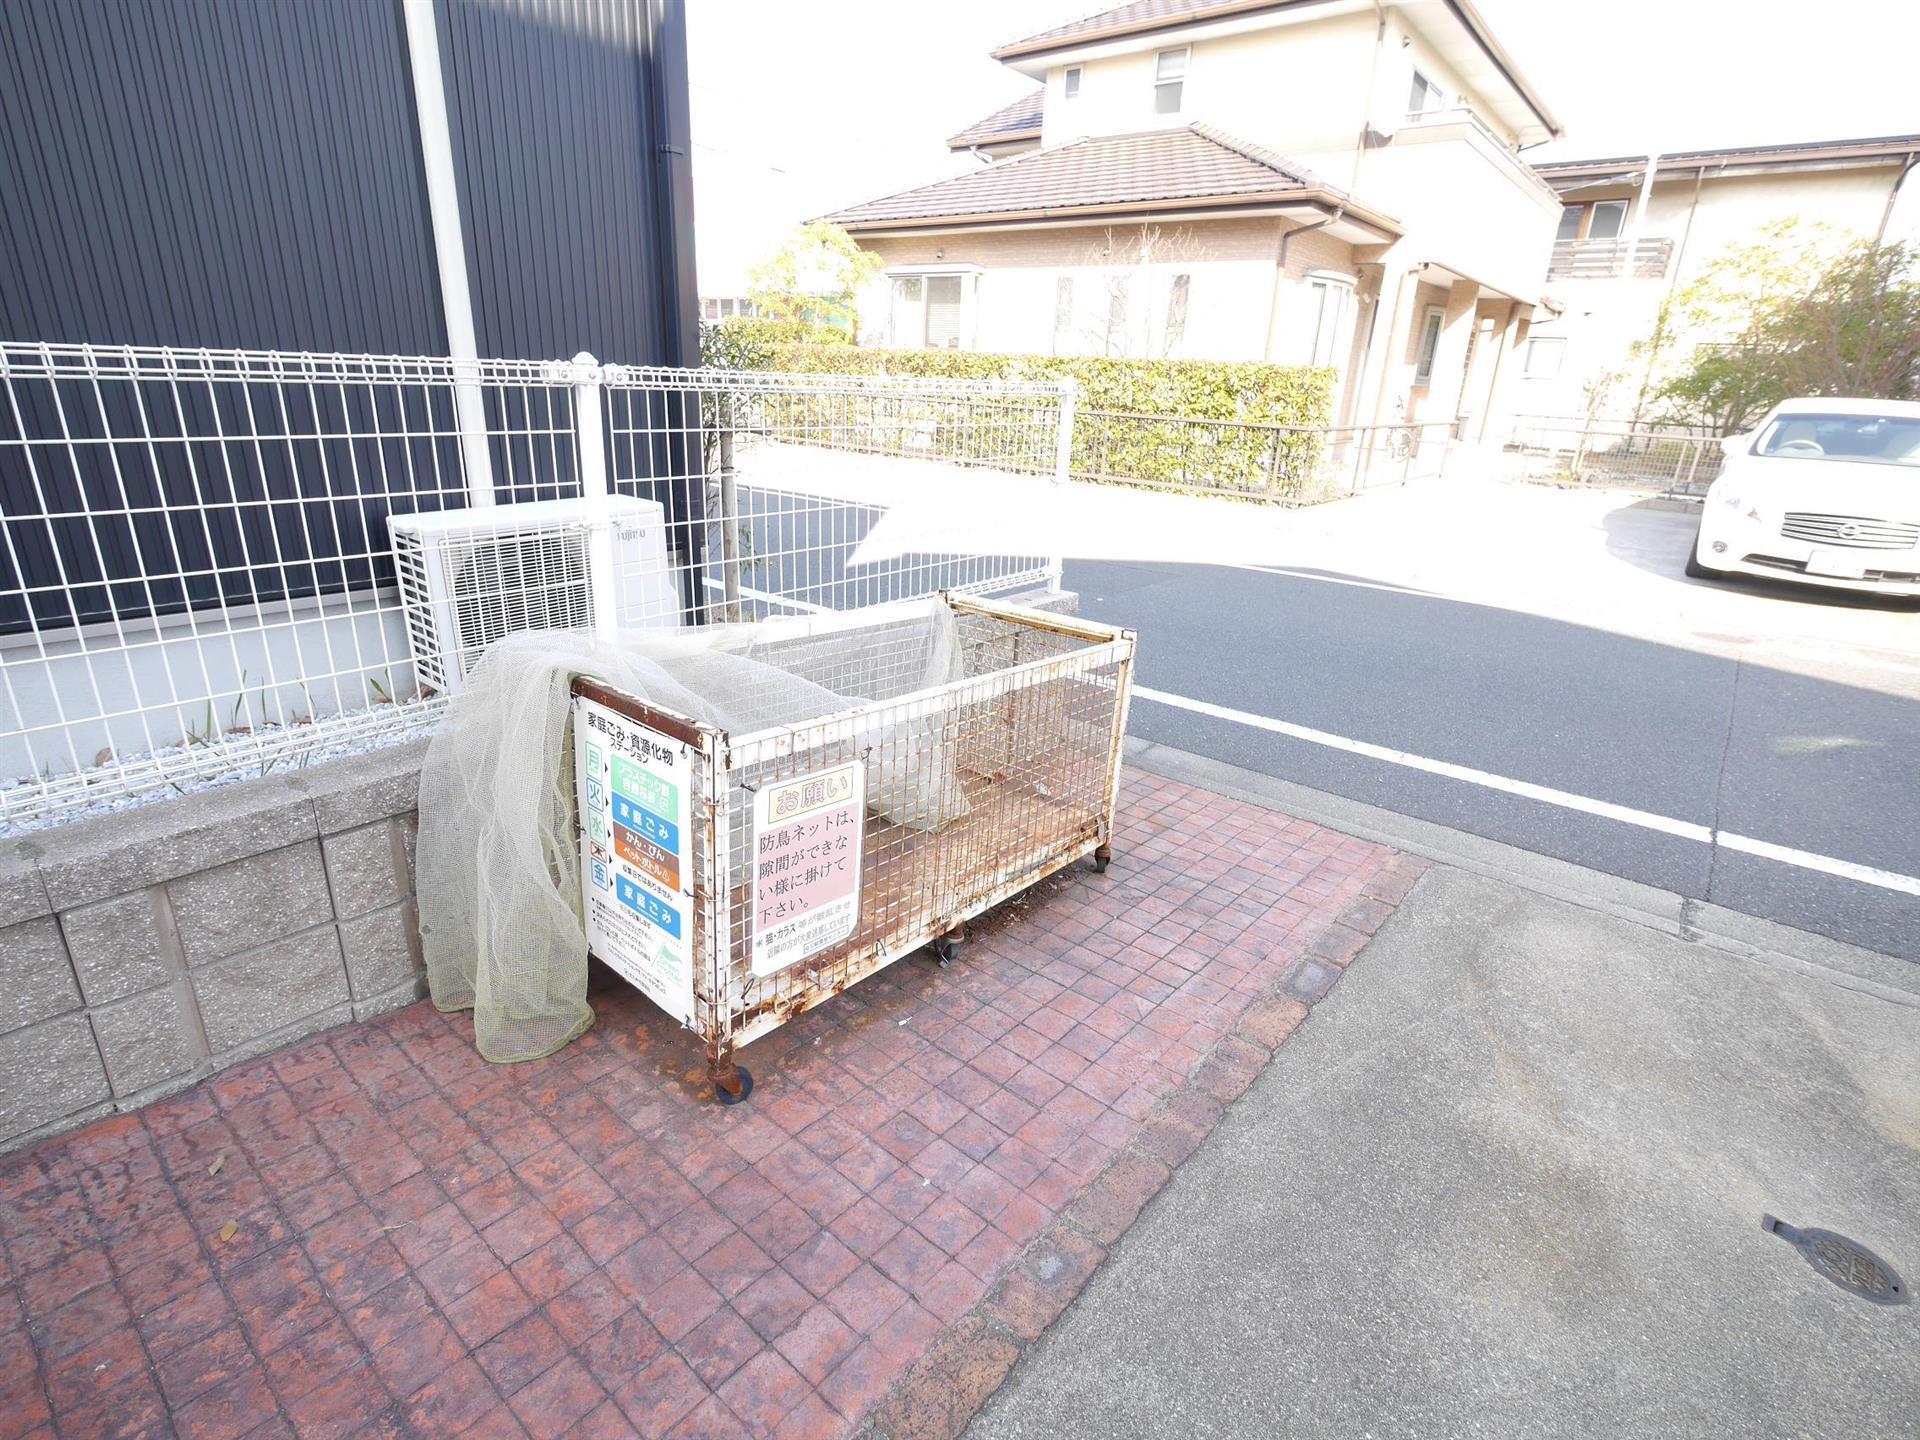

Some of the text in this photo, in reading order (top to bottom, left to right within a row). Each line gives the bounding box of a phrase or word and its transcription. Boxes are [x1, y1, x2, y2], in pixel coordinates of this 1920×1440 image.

[617, 529, 646, 541] UJITU
[587, 711, 674, 767] 家庭ごみ・資源化物
[610, 738, 649, 764] ステーション
[589, 750, 600, 772] 月
[590, 786, 601, 804] 火
[776, 776, 849, 815] お願い
[591, 816, 603, 835] 水
[759, 811, 855, 854] 防鳥ネットは、
[626, 831, 666, 862] かん・びん
[759, 835, 848, 880] 隙間ができな
[593, 864, 606, 884] 金
[759, 856, 847, 901] い様に掛けて
[759, 896, 809, 925] 下さい。
